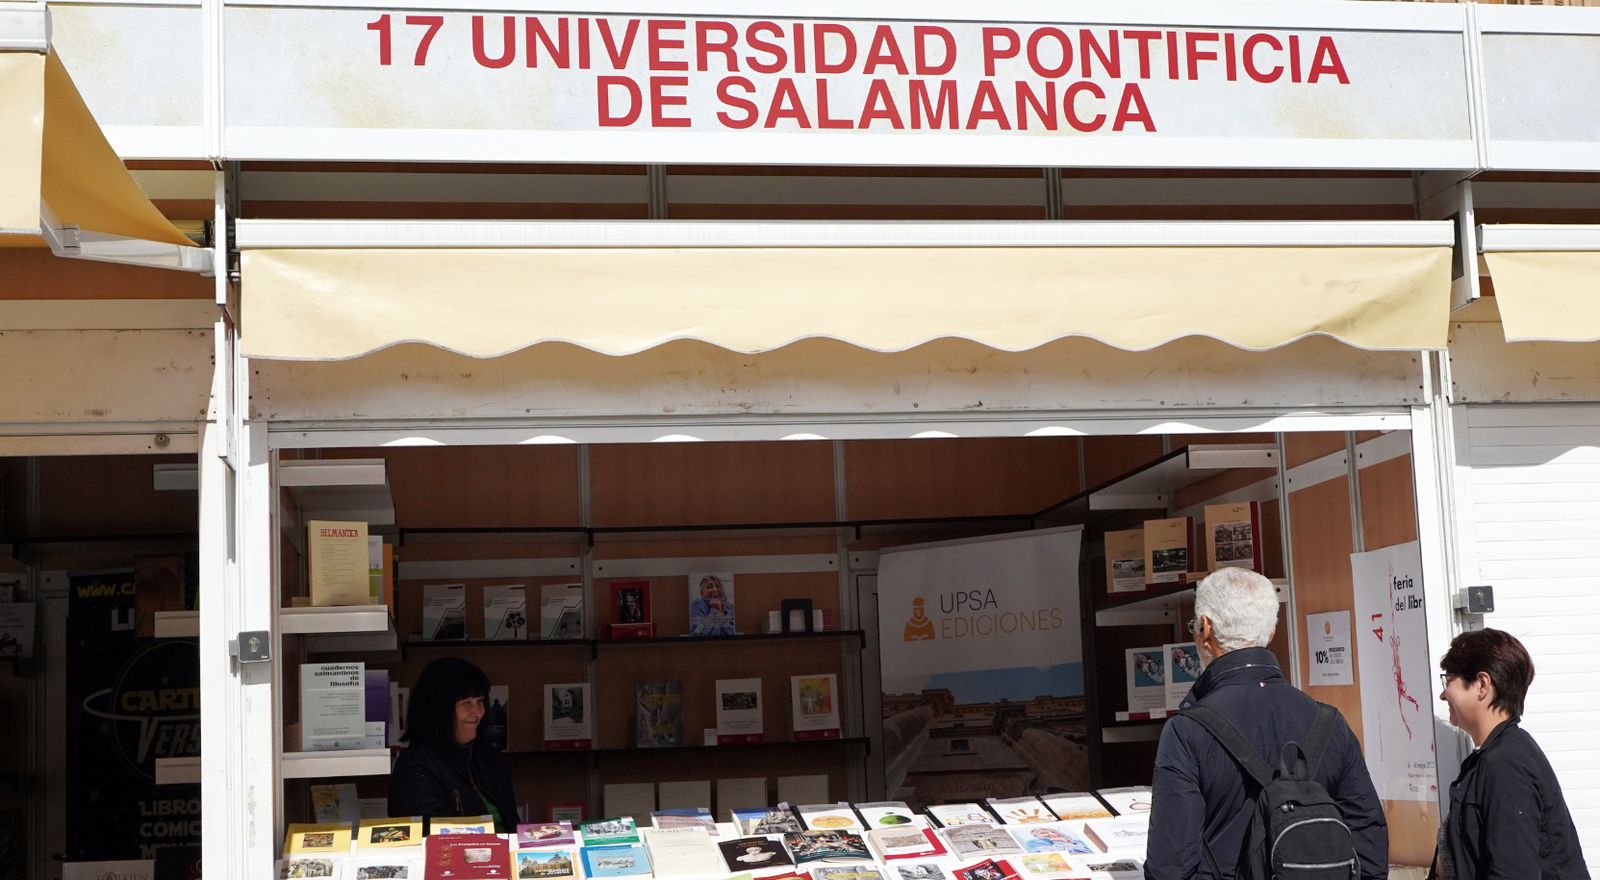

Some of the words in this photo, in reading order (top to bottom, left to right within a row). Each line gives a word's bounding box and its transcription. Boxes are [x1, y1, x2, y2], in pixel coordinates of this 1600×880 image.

[366, 14, 444, 66] 17
[471, 15, 957, 76] UNIVERSIDAD
[982, 26, 1351, 85] PONTIFICIA
[597, 75, 692, 128] DE
[715, 75, 1157, 133] SALAMANCA
[1393, 575, 1413, 590] feria
[940, 588, 998, 614] UPSA
[1395, 596, 1406, 612] del
[941, 607, 1063, 640] EDICIONES
[1371, 613, 1384, 642] 41
[1315, 650, 1329, 665] 10%
